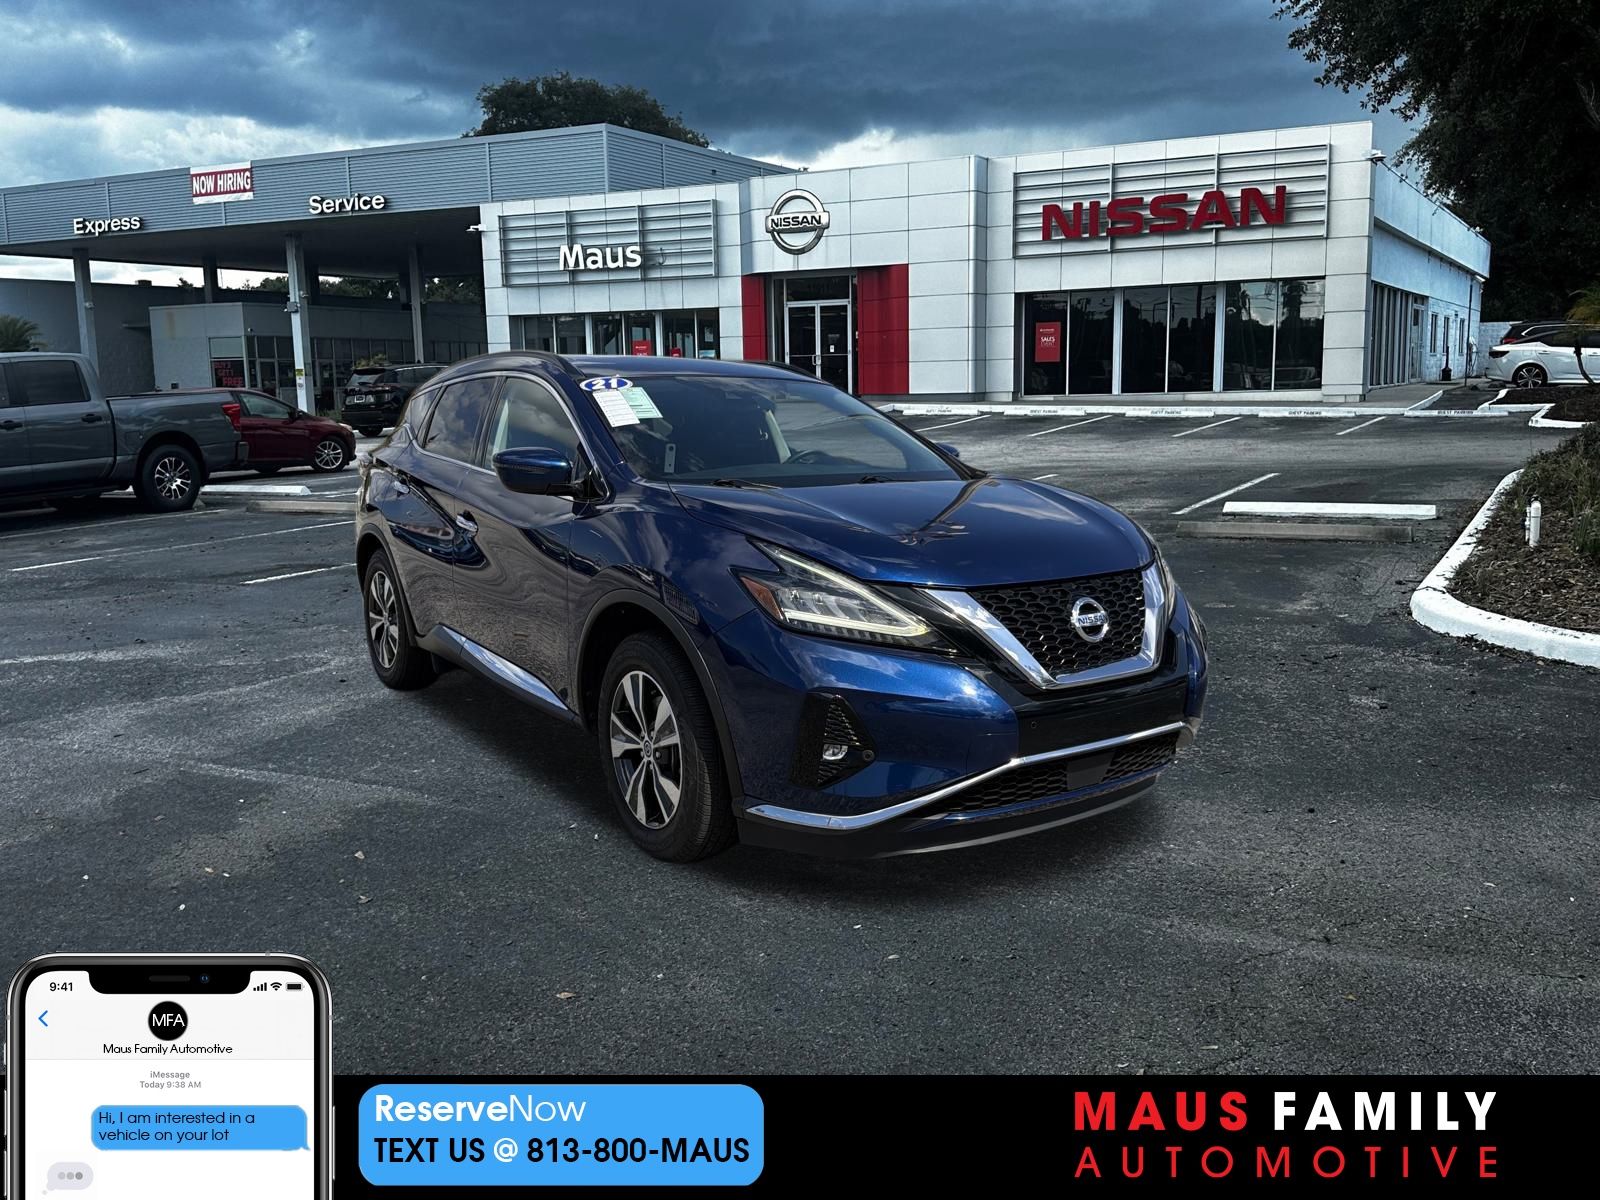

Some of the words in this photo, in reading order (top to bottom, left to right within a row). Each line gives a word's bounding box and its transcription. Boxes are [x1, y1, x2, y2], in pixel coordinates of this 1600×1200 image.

[192, 175, 214, 195] NOW
[217, 171, 251, 192] HIRING
[309, 193, 386, 215] Service
[1042, 185, 1287, 241] NISSAN
[73, 215, 141, 237] Express
[770, 214, 823, 230] NISSAN
[559, 243, 642, 270] Maus
[592, 378, 618, 389] 21
